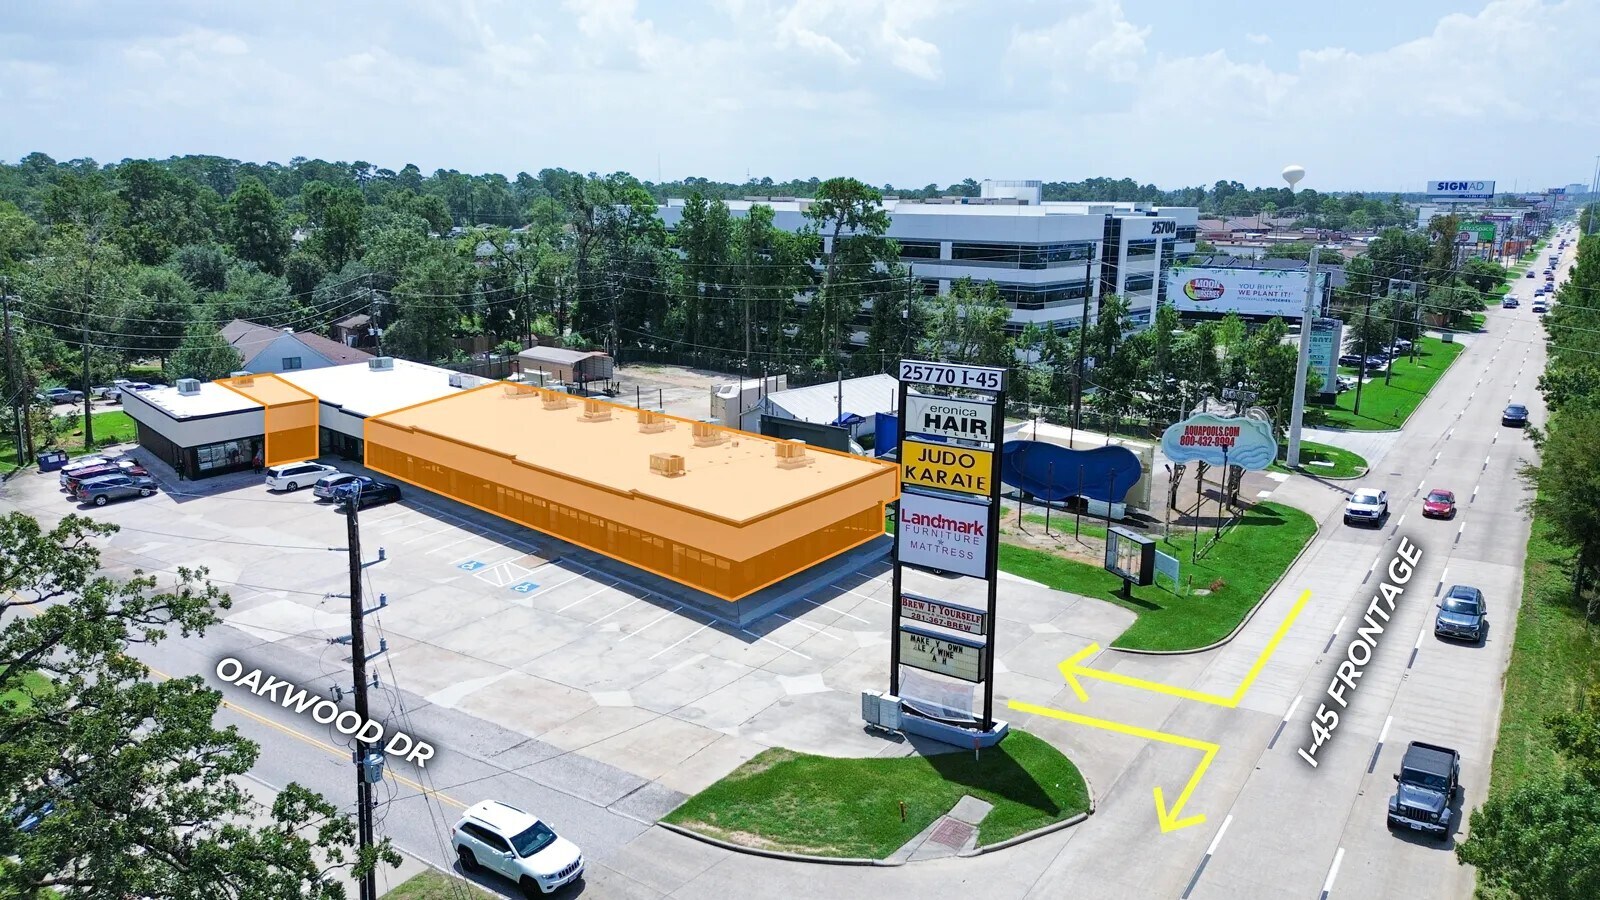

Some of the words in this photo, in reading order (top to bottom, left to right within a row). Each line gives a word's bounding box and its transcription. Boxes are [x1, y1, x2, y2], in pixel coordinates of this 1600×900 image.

[1151, 221, 1176, 234] 25700
[1195, 280, 1220, 289] MOON
[902, 365, 956, 384] 25770
[961, 370, 998, 388] I-45
[922, 428, 989, 440] STYLIST
[924, 413, 988, 436] HAIR
[1184, 425, 1240, 437] AQUAPOOLS.COM
[1180, 435, 1235, 447] 800-432-8994
[918, 448, 976, 469] JUDO
[905, 465, 987, 490] KARATE
[901, 508, 985, 537] Landmark
[905, 524, 980, 546] FURNITURE
[910, 540, 974, 560] MATTRESS
[911, 612, 972, 631] 281-367-BREW
[910, 634, 930, 646] MAKE
[936, 640, 940, 648] Y
[948, 643, 964, 654] OWN
[938, 648, 954, 659] WINE
